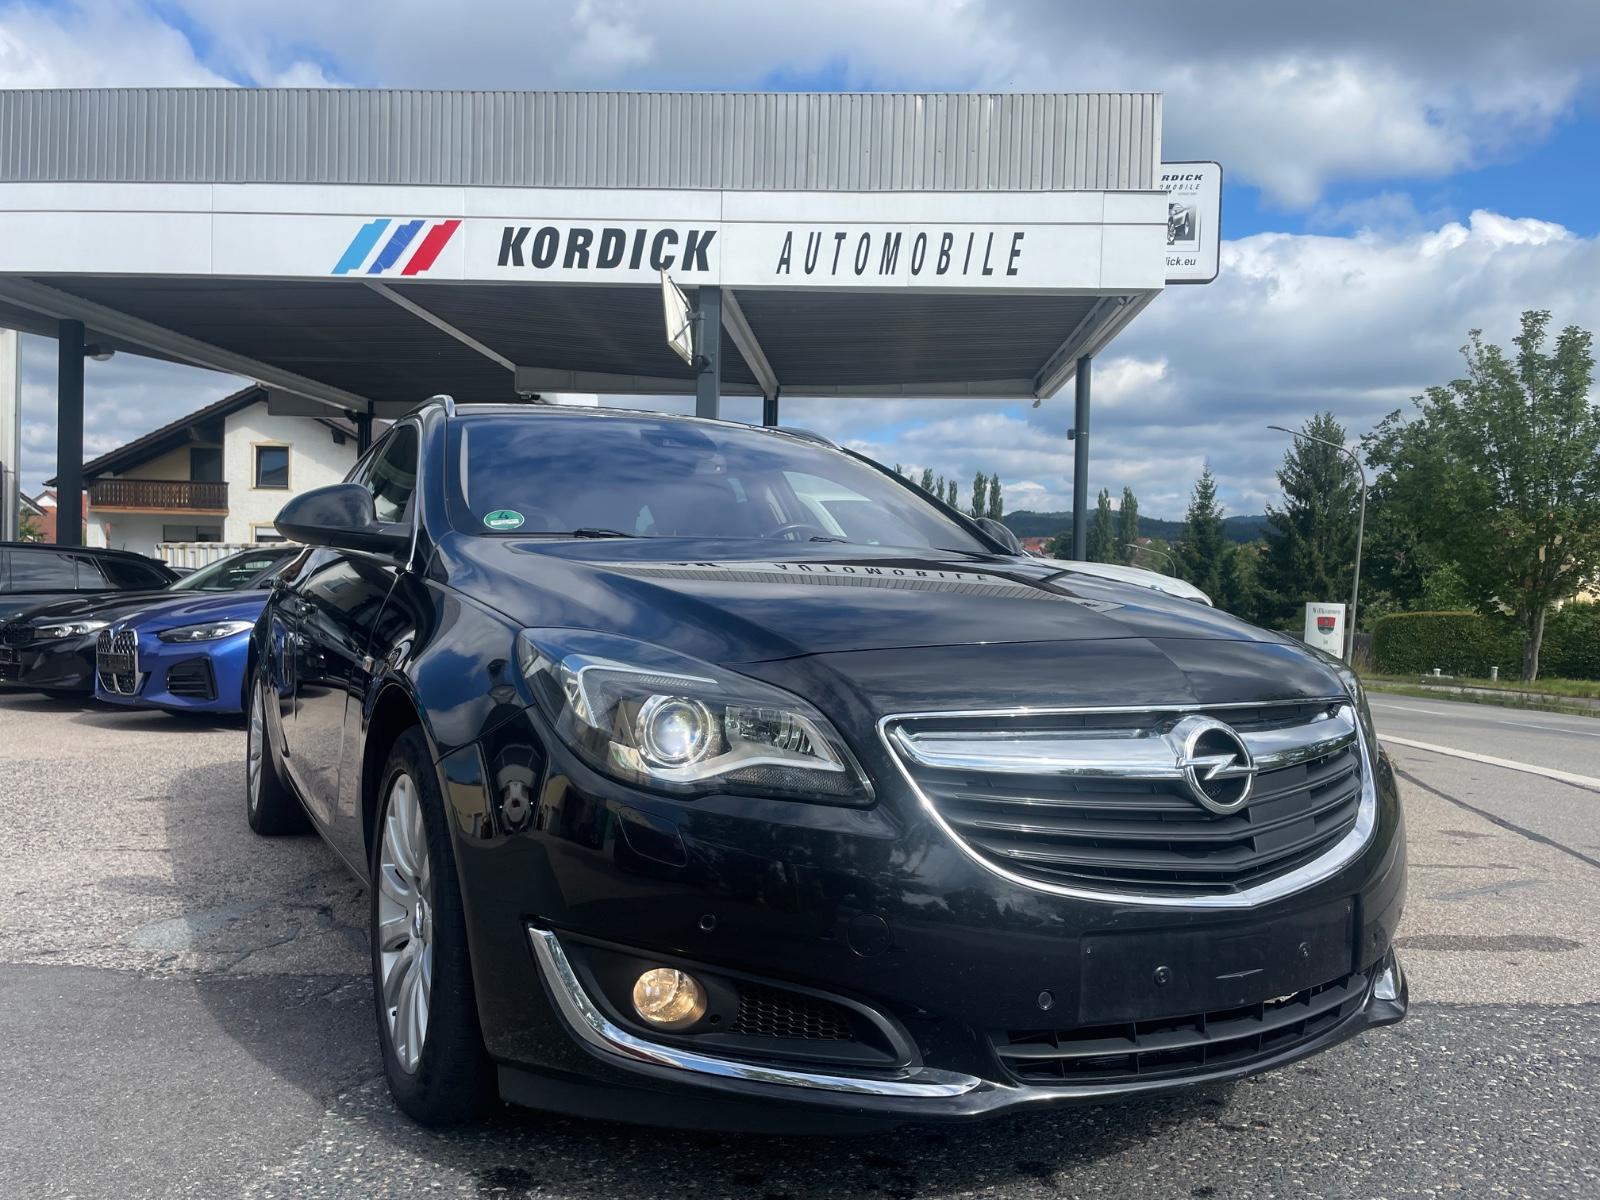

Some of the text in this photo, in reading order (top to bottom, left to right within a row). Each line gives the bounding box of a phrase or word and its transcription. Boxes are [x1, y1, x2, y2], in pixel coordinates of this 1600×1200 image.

[497, 226, 1025, 276] KORDICK AUTOMOBILE
[1166, 256, 1197, 266] ick.eu
